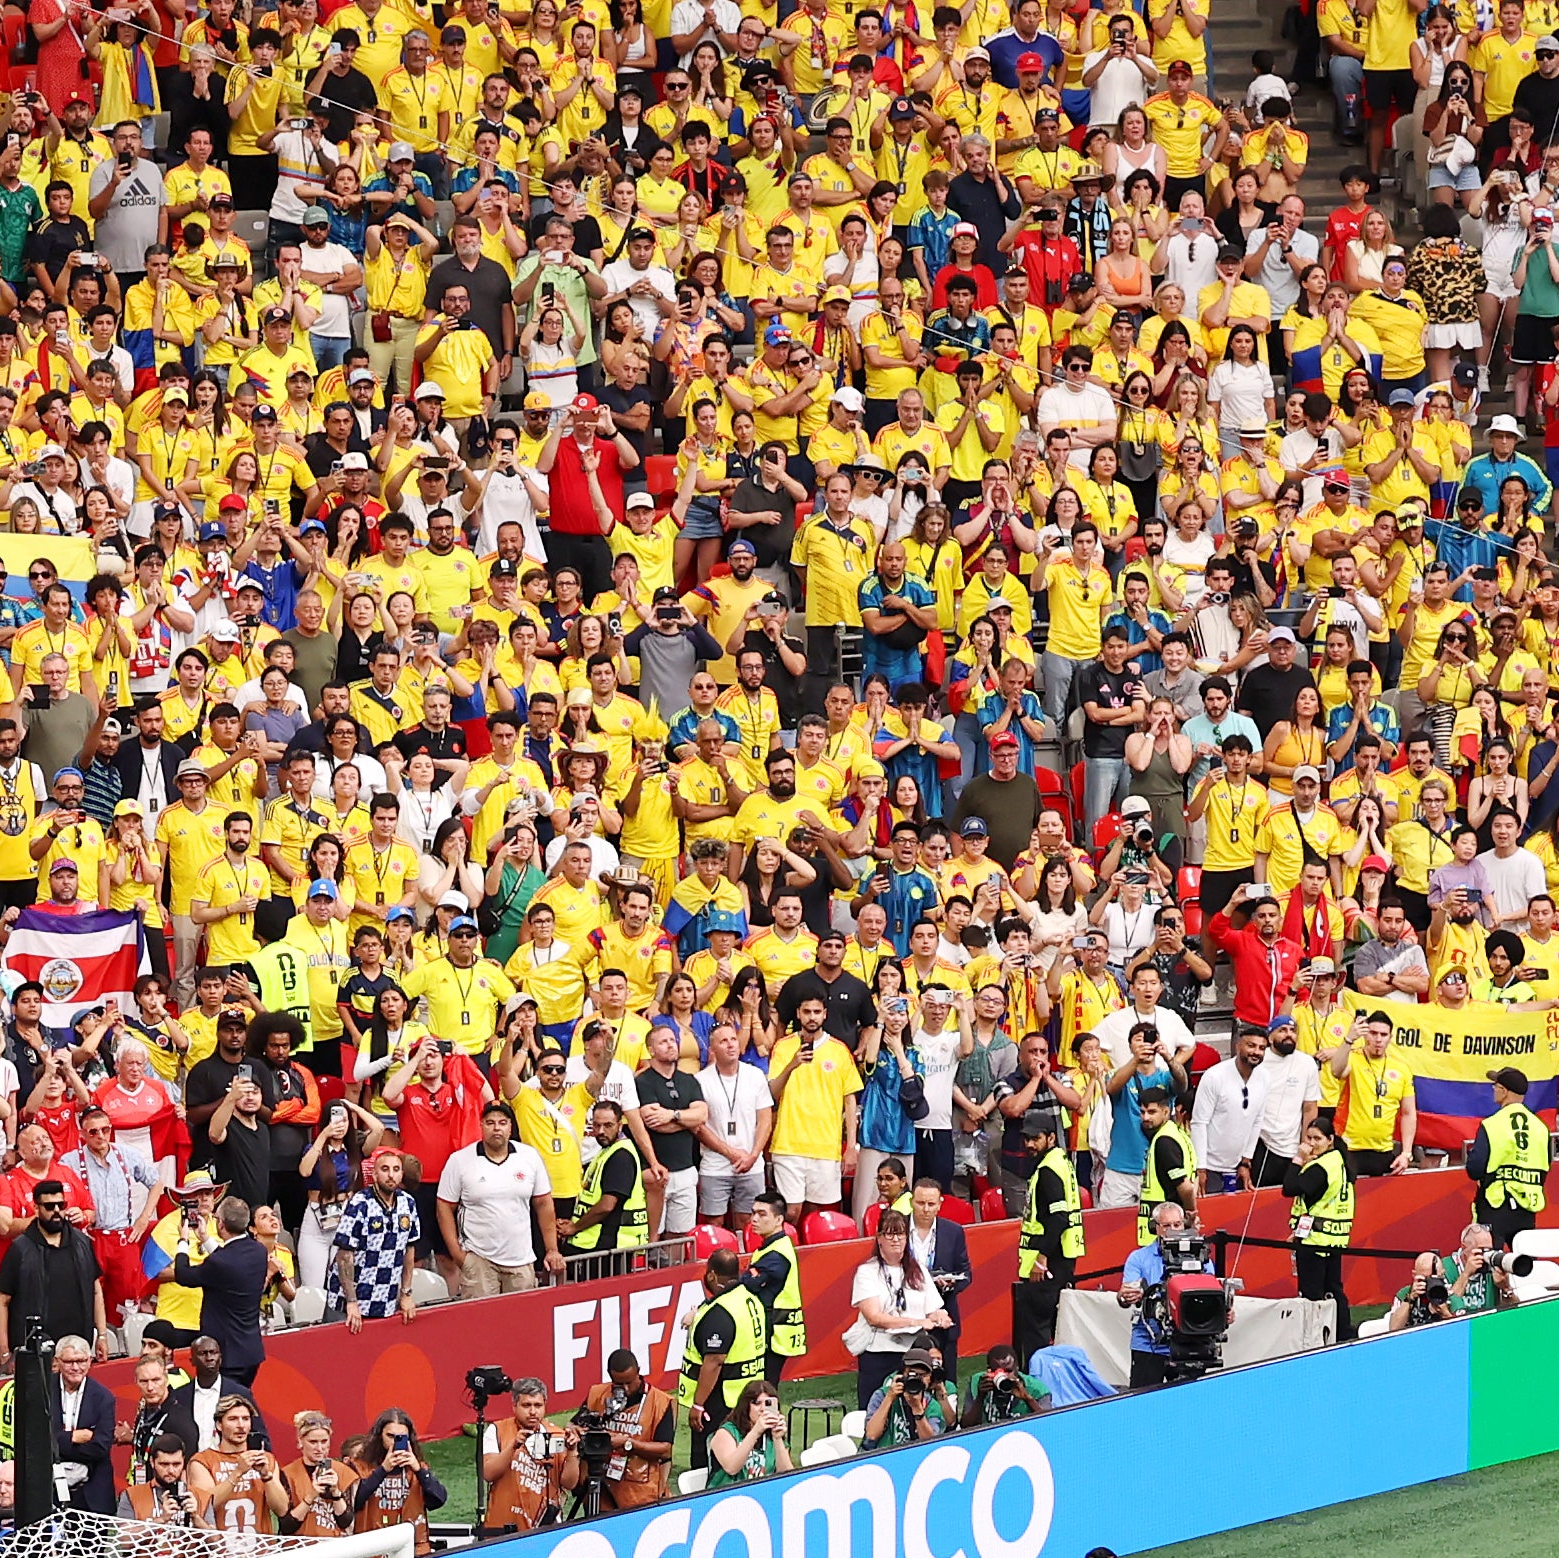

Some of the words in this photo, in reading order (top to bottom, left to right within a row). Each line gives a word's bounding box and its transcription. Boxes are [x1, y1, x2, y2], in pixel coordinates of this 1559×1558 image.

[120, 194, 157, 208] adidas
[1396, 1027, 1423, 1049] GOL
[1433, 1032, 1453, 1053] DE
[1463, 1034, 1536, 1057] DAVINSON
